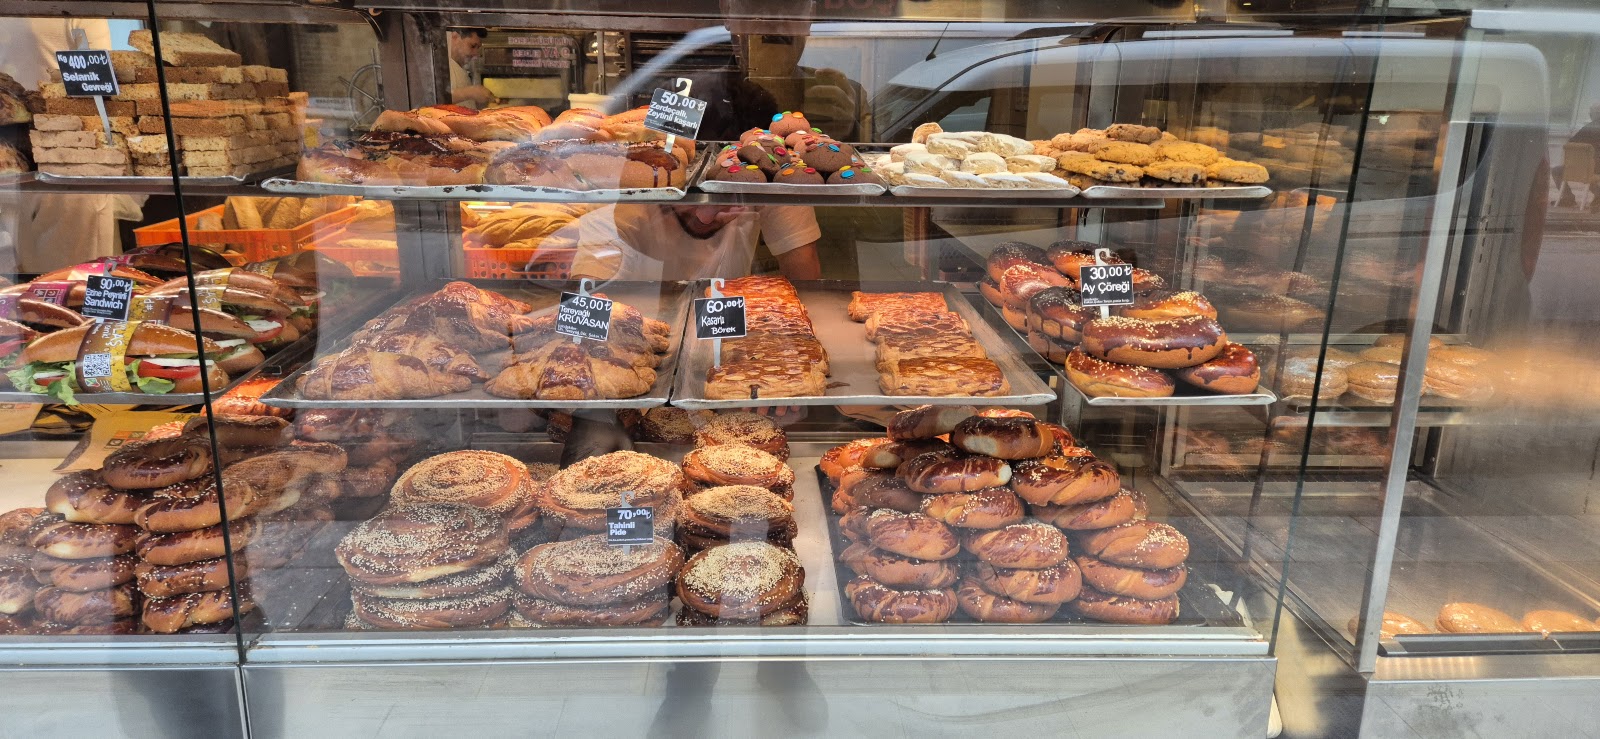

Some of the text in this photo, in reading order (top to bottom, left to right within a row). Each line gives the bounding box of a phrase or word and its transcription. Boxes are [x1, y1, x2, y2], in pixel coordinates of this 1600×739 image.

[57, 54, 68, 63] Kg
[62, 72, 101, 82] Selanik
[81, 82, 113, 93] Gevreği
[647, 109, 674, 122] Zeytinli
[85, 288, 102, 297] Ezine
[1082, 281, 1130, 295] Ay Çöreği
[84, 296, 124, 310] Sandwich
[560, 304, 591, 318] Tereyağlı
[558, 312, 610, 330] KRUVASAN
[608, 521, 636, 529] Tahinli
